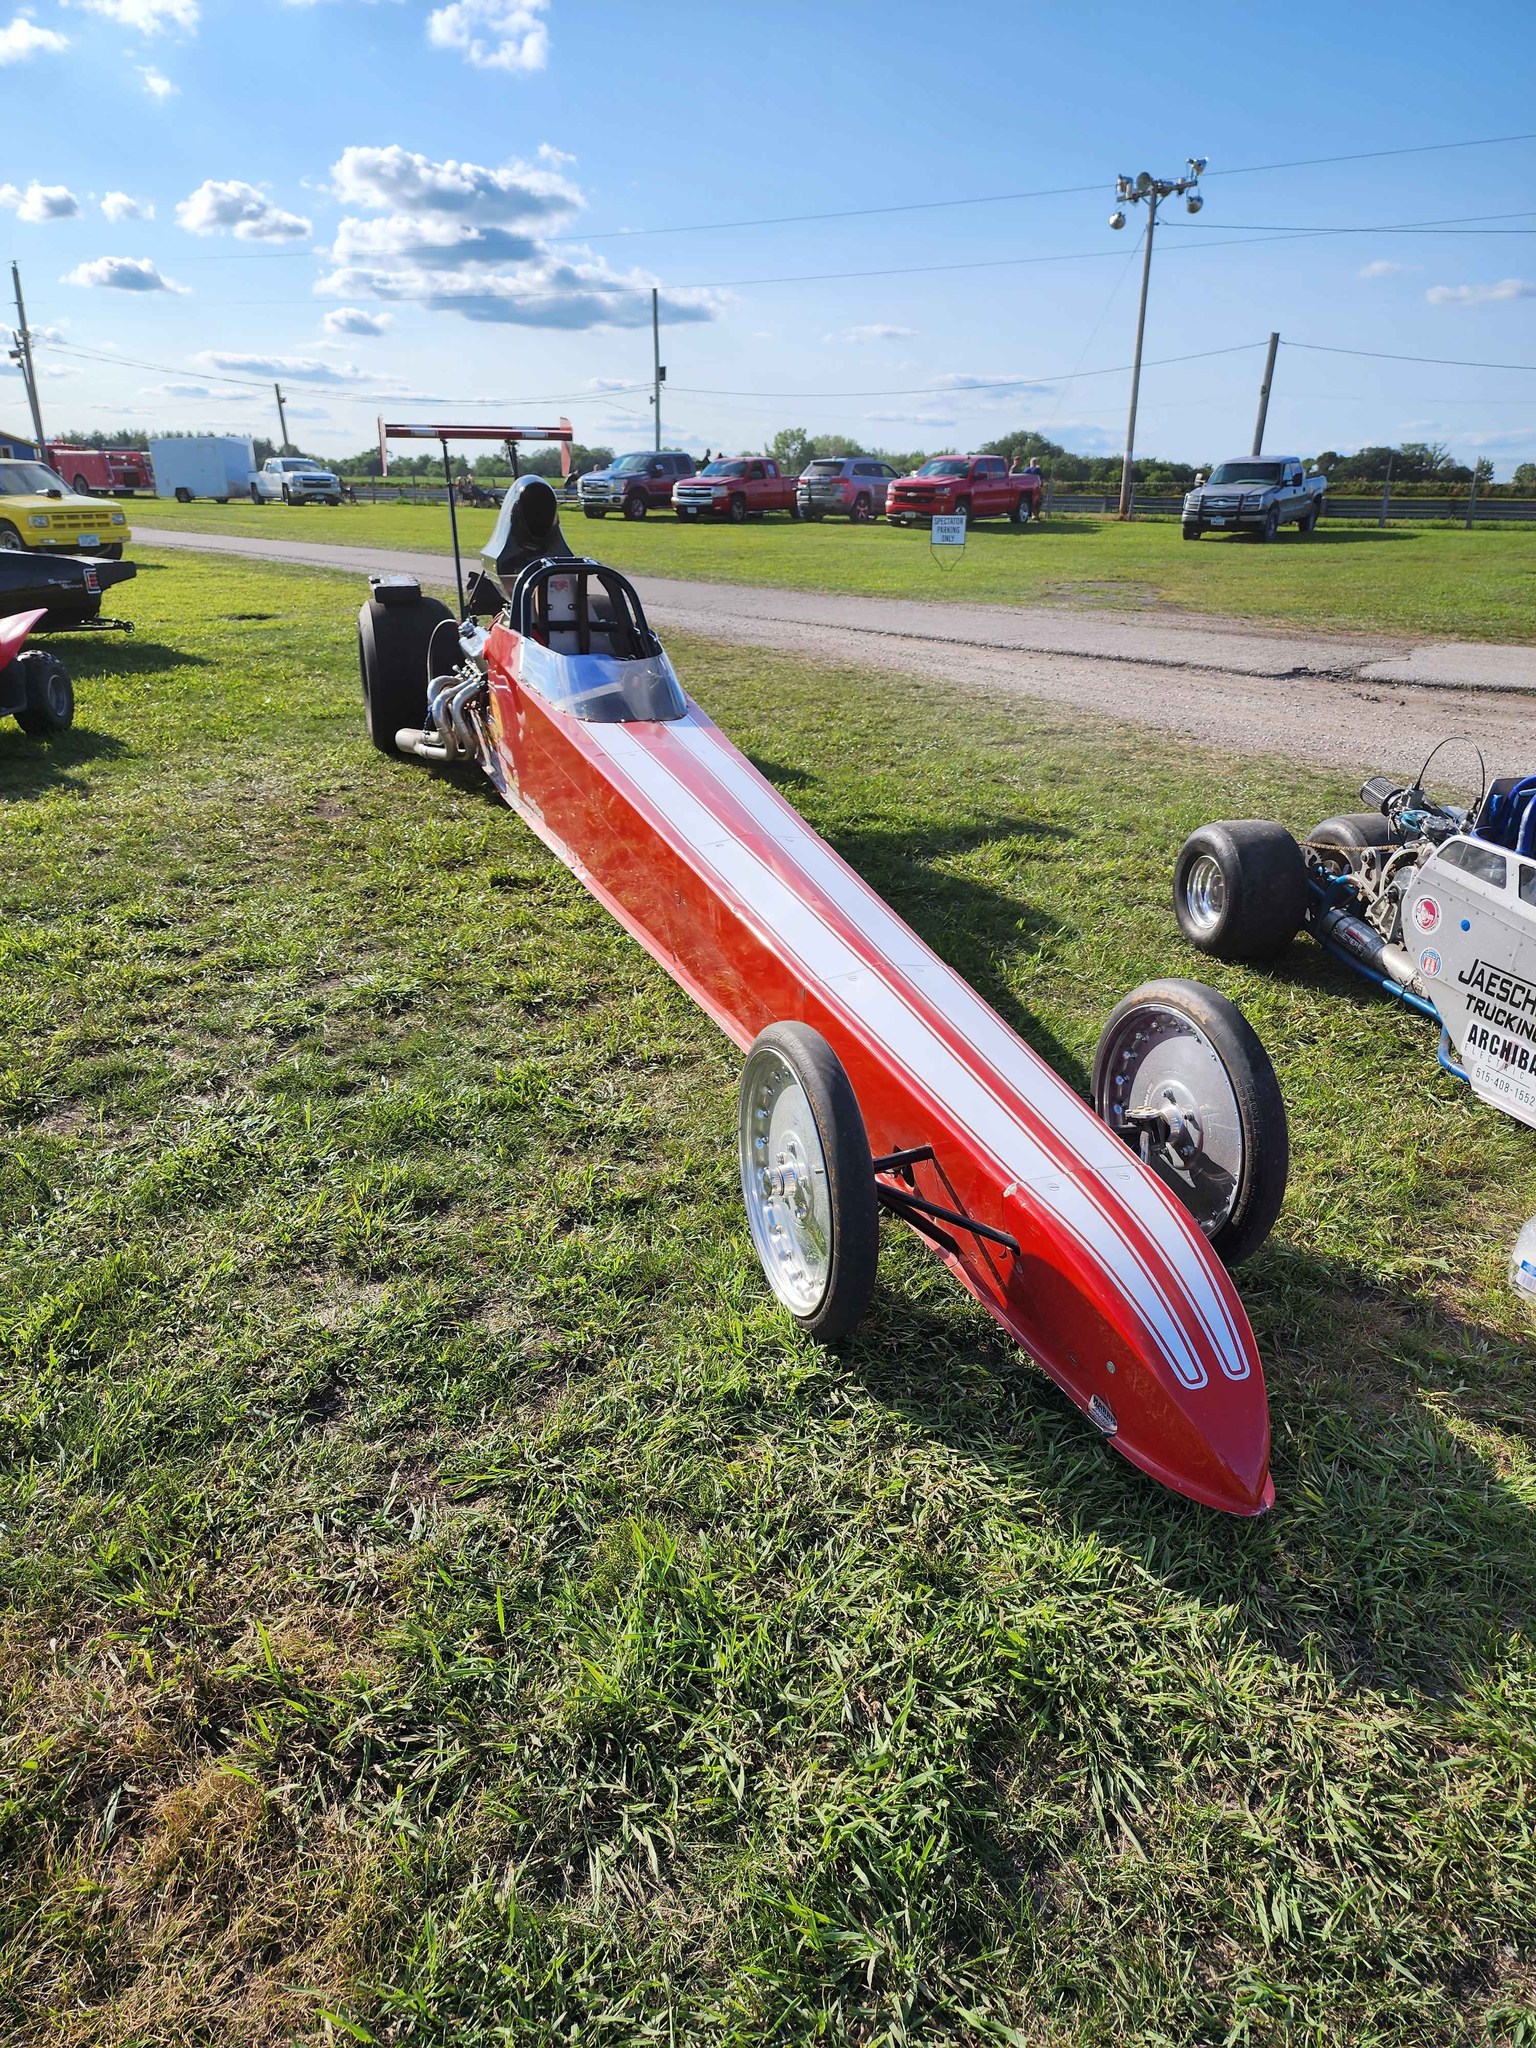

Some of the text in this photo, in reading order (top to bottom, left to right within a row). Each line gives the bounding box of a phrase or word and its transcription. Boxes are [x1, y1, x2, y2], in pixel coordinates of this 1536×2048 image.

[934, 517, 963, 525] SPECTATOR
[1464, 1043, 1524, 1079] ELECTRIC
[1475, 1067, 1536, 1107] 515-408-1552
